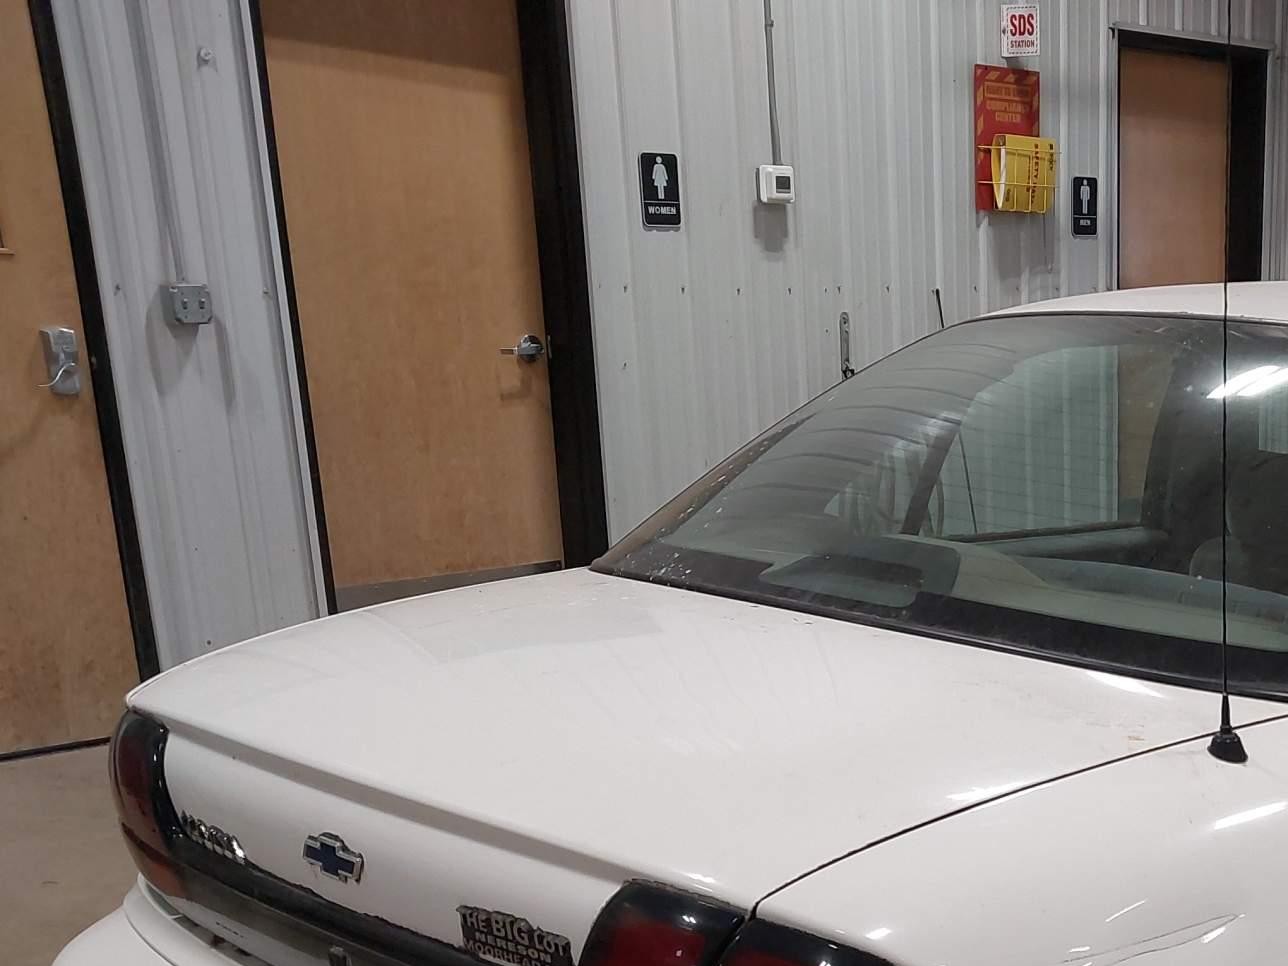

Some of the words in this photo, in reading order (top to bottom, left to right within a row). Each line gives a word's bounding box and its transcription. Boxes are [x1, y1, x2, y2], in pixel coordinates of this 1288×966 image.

[1009, 13, 1035, 37] SDS
[1010, 39, 1035, 49] STATION
[648, 205, 677, 215] WOMEN
[459, 907, 489, 932] THE
[491, 911, 530, 946] BIG
[533, 925, 571, 957] LOT
[475, 931, 552, 963] NERESON
